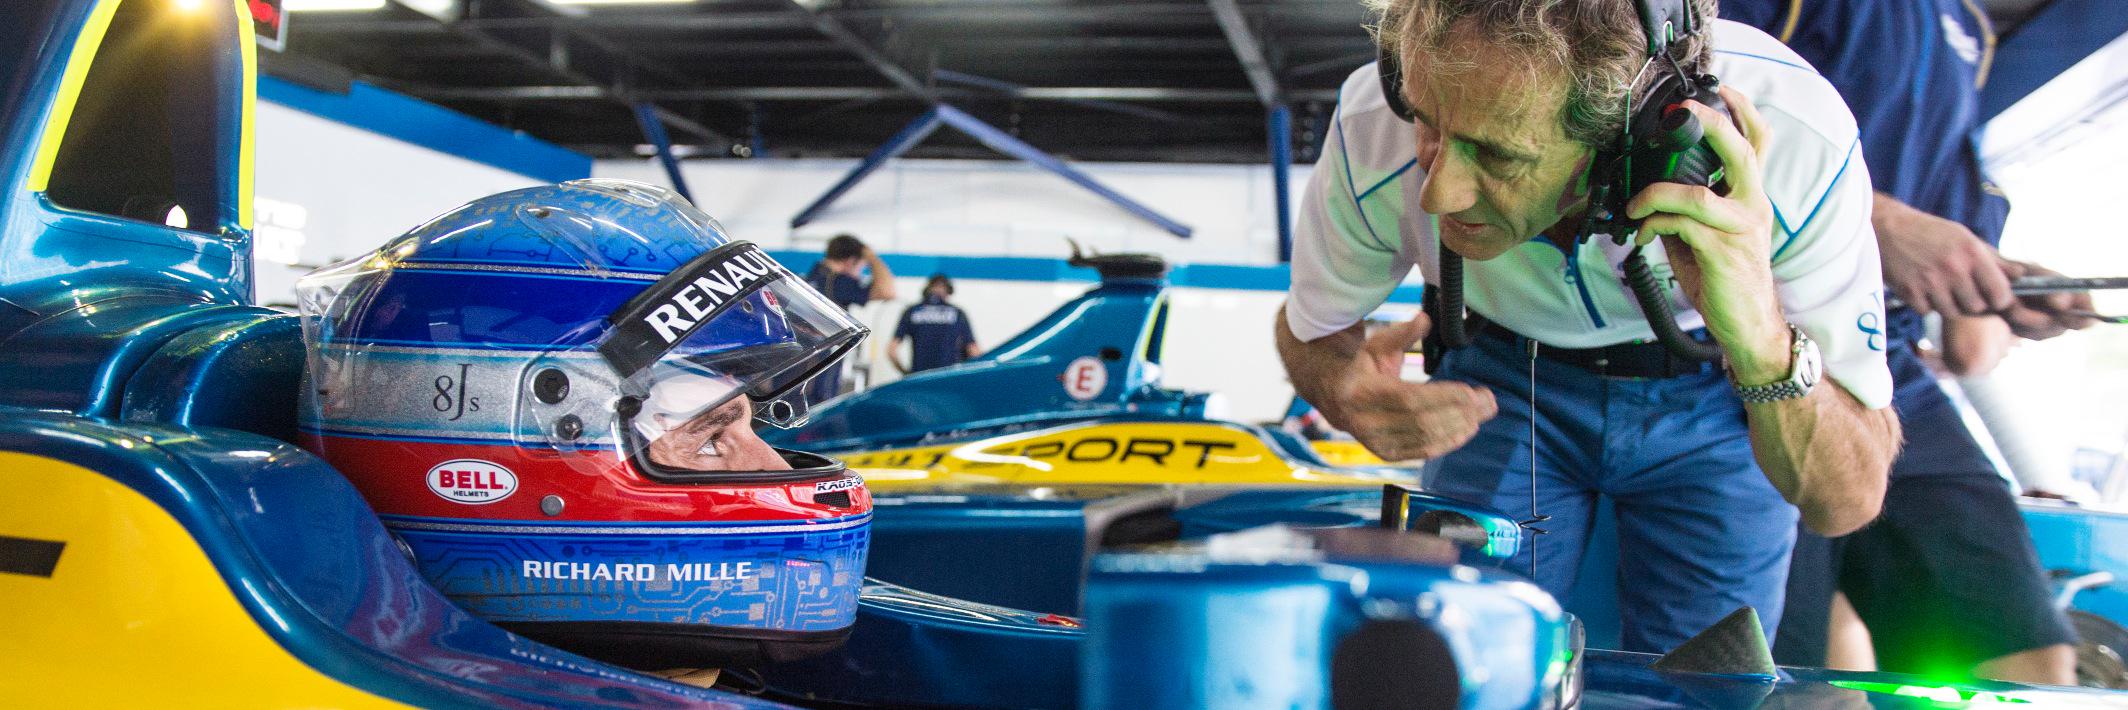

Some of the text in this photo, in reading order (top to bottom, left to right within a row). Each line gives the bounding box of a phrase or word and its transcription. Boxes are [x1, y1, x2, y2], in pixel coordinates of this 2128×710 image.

[644, 250, 771, 344] RENAUL
[1076, 366, 1094, 392] E
[433, 363, 480, 422] 8Js
[438, 470, 504, 490] BELL
[453, 490, 489, 498] HELMETS
[523, 560, 753, 582] RICHARD MILLE
